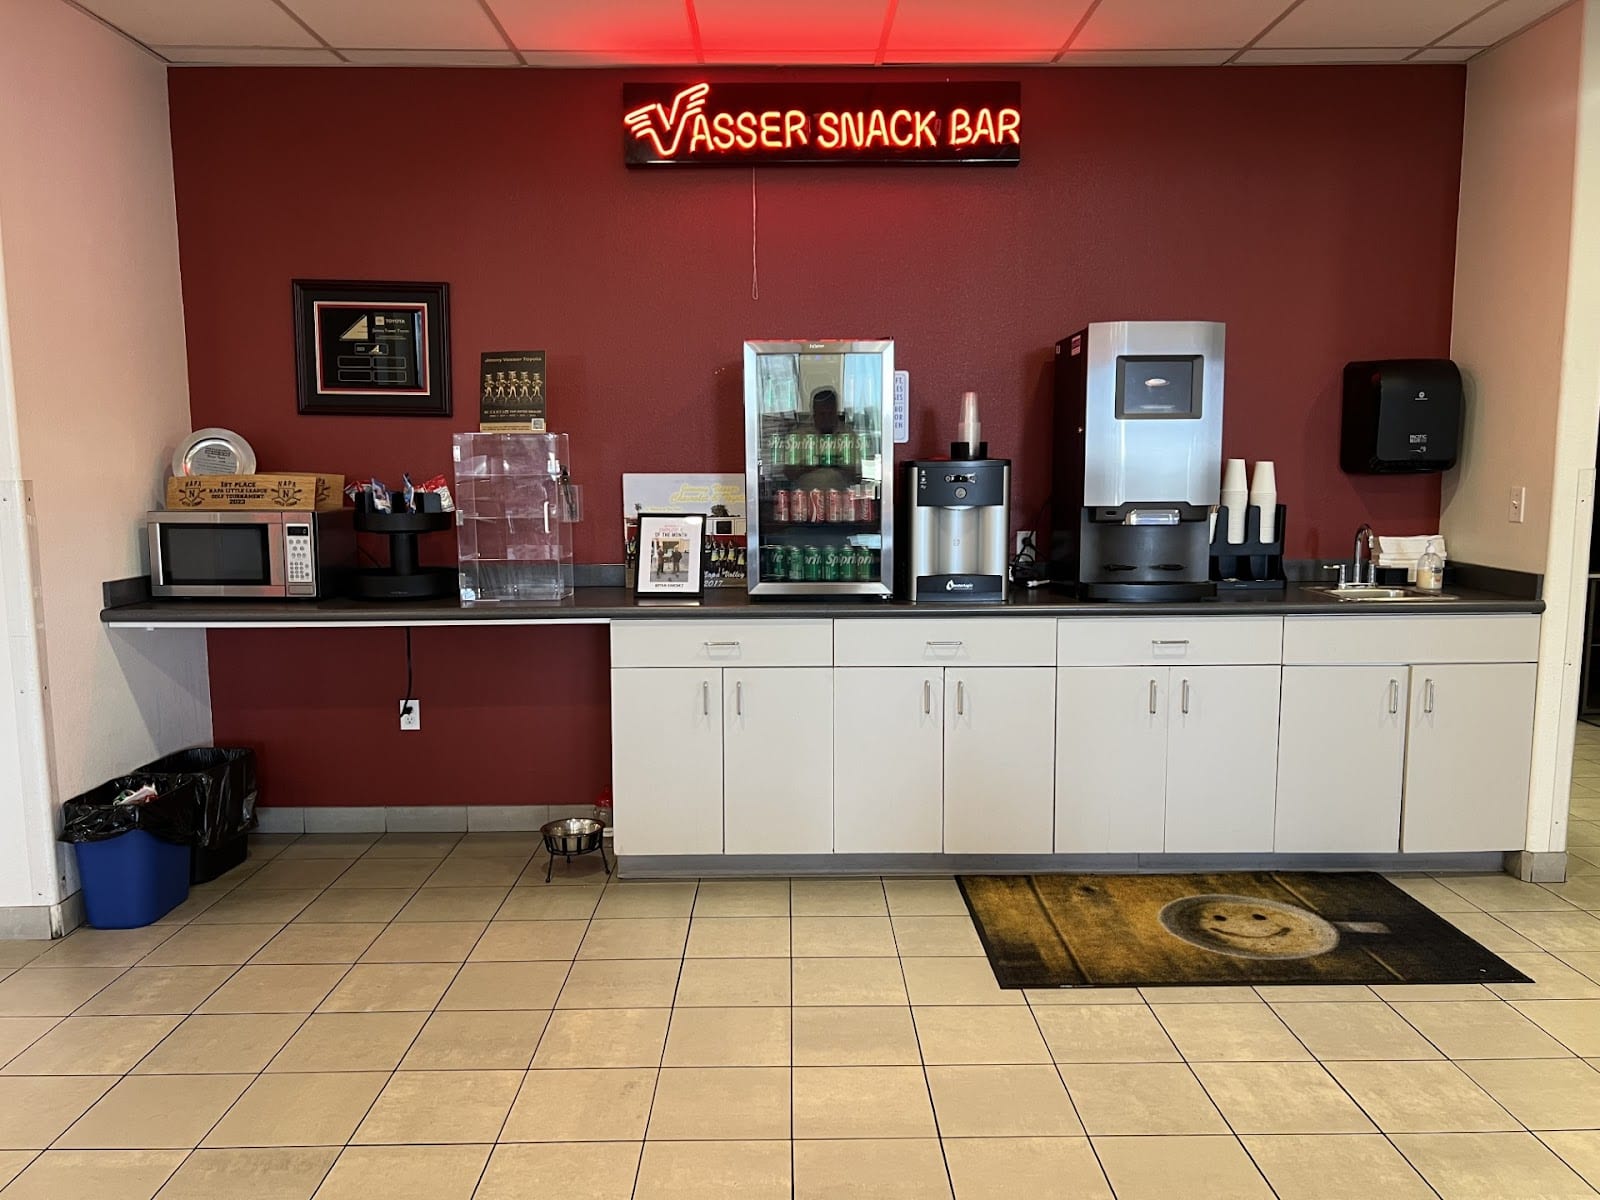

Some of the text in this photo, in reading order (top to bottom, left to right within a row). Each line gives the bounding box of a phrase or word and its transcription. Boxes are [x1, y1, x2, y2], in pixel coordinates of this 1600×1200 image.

[624, 82, 1021, 156] VASSER SNACK BAR
[277, 480, 297, 488] NAPA
